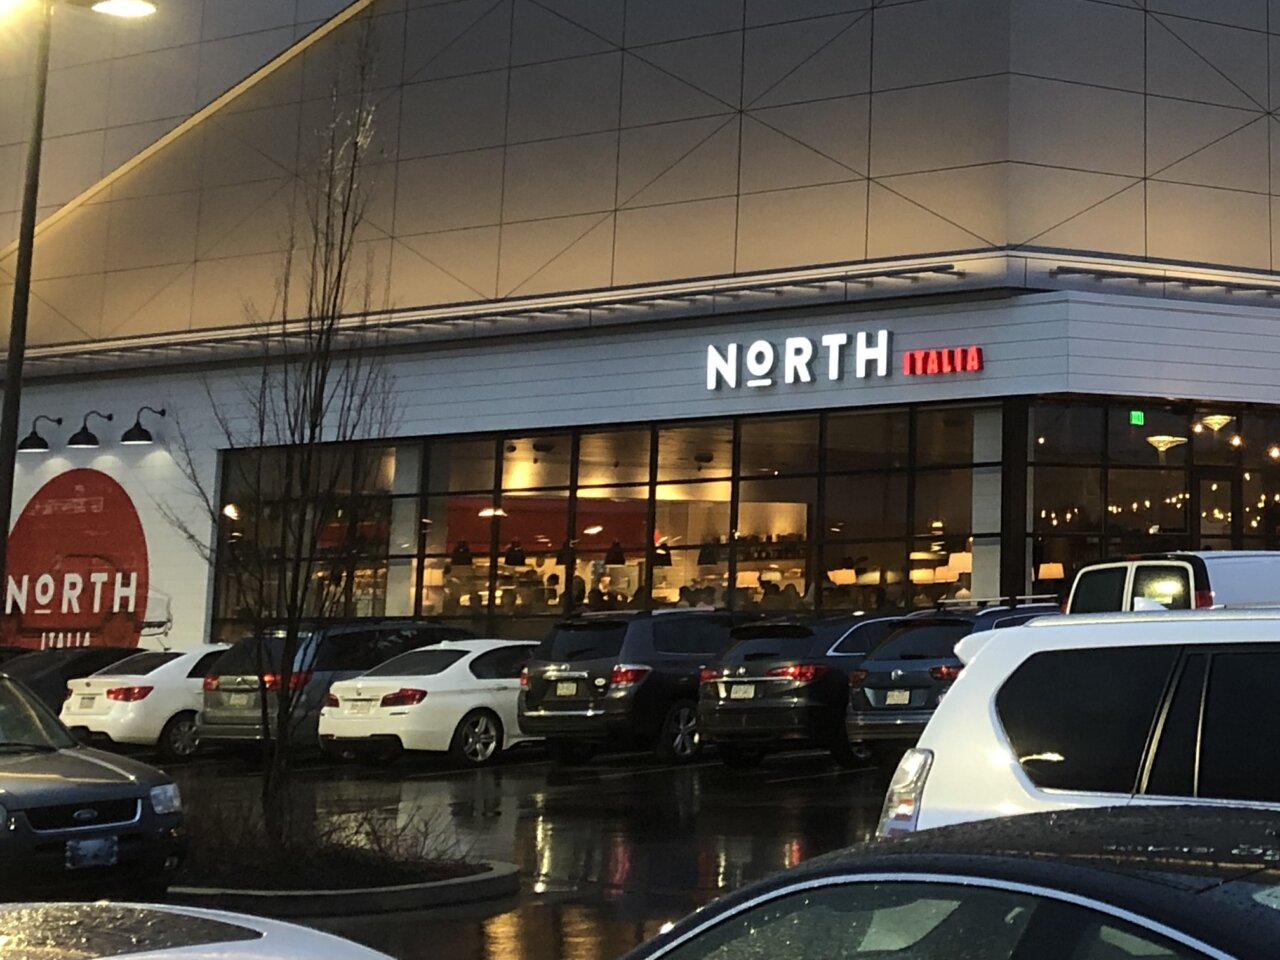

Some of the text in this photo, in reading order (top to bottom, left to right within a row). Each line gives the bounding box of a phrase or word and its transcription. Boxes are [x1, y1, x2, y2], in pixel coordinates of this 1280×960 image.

[706, 329, 981, 390] NORTH ITALIA
[4, 572, 138, 615] NORTH
